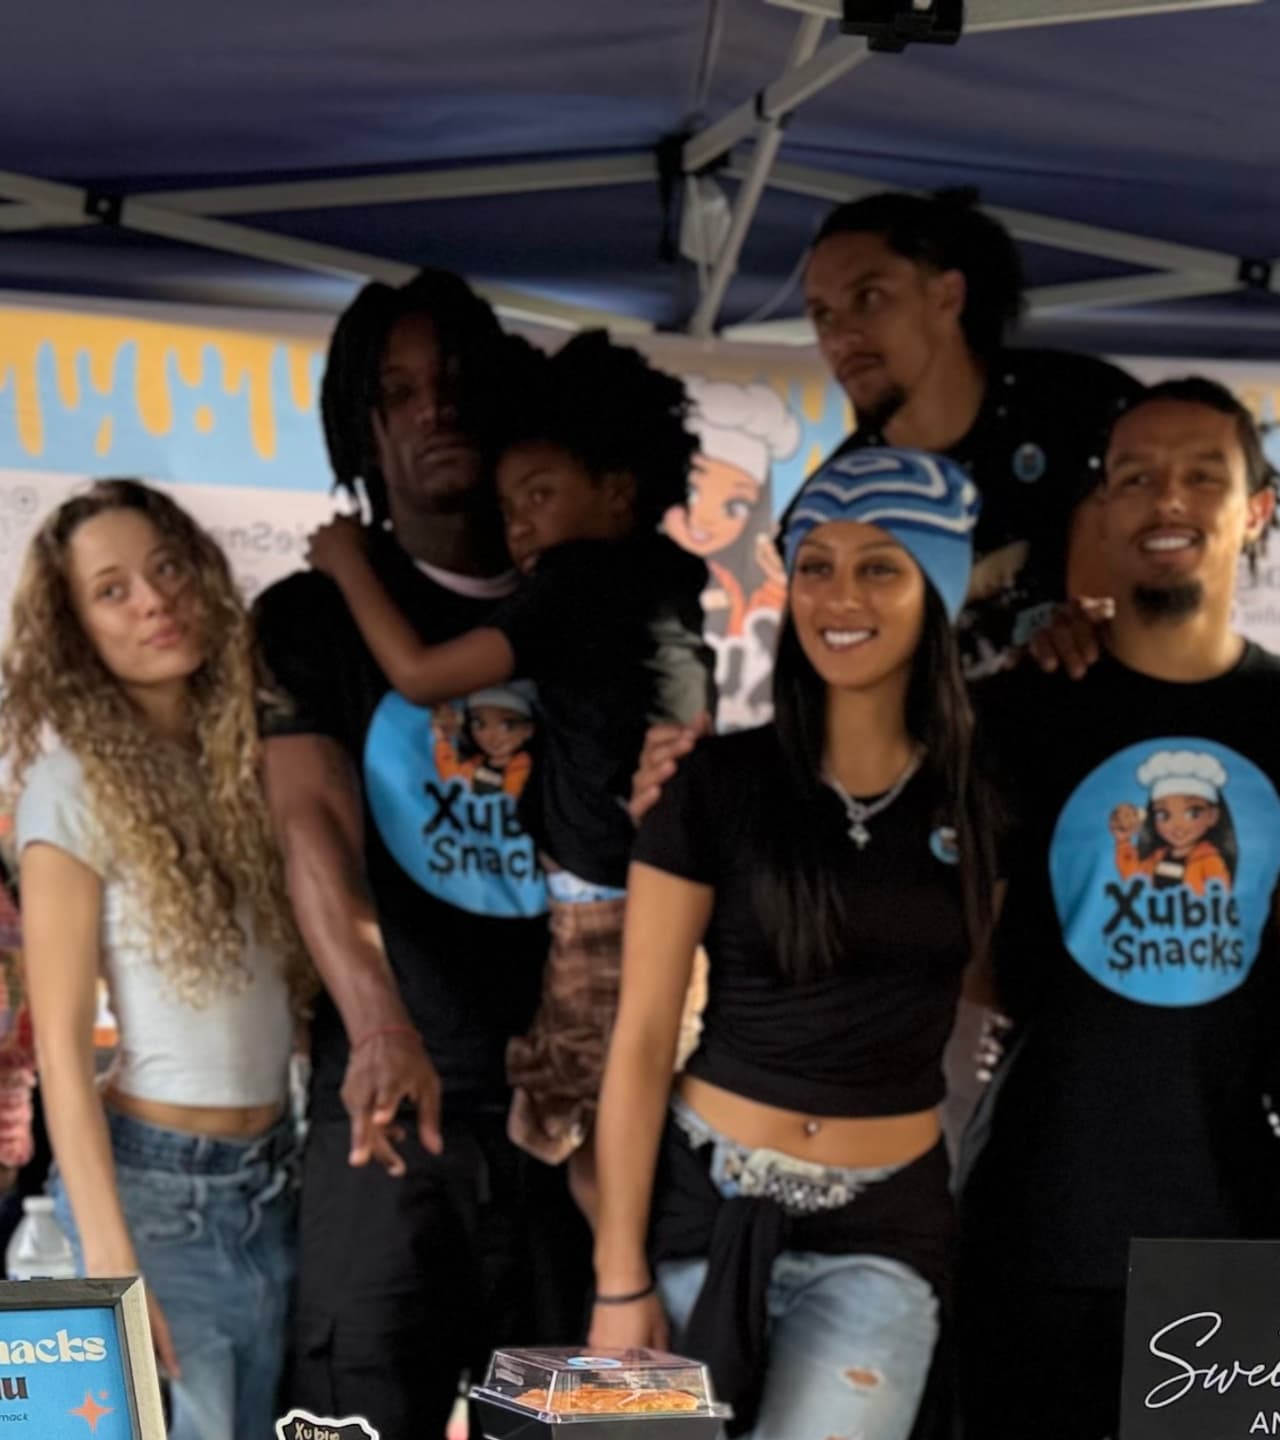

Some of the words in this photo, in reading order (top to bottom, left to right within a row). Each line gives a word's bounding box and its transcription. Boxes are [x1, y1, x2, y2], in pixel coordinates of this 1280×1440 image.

[423, 780, 525, 837] Xub
[1102, 878, 1241, 936] Xubie
[1108, 932, 1244, 975] Snacks
